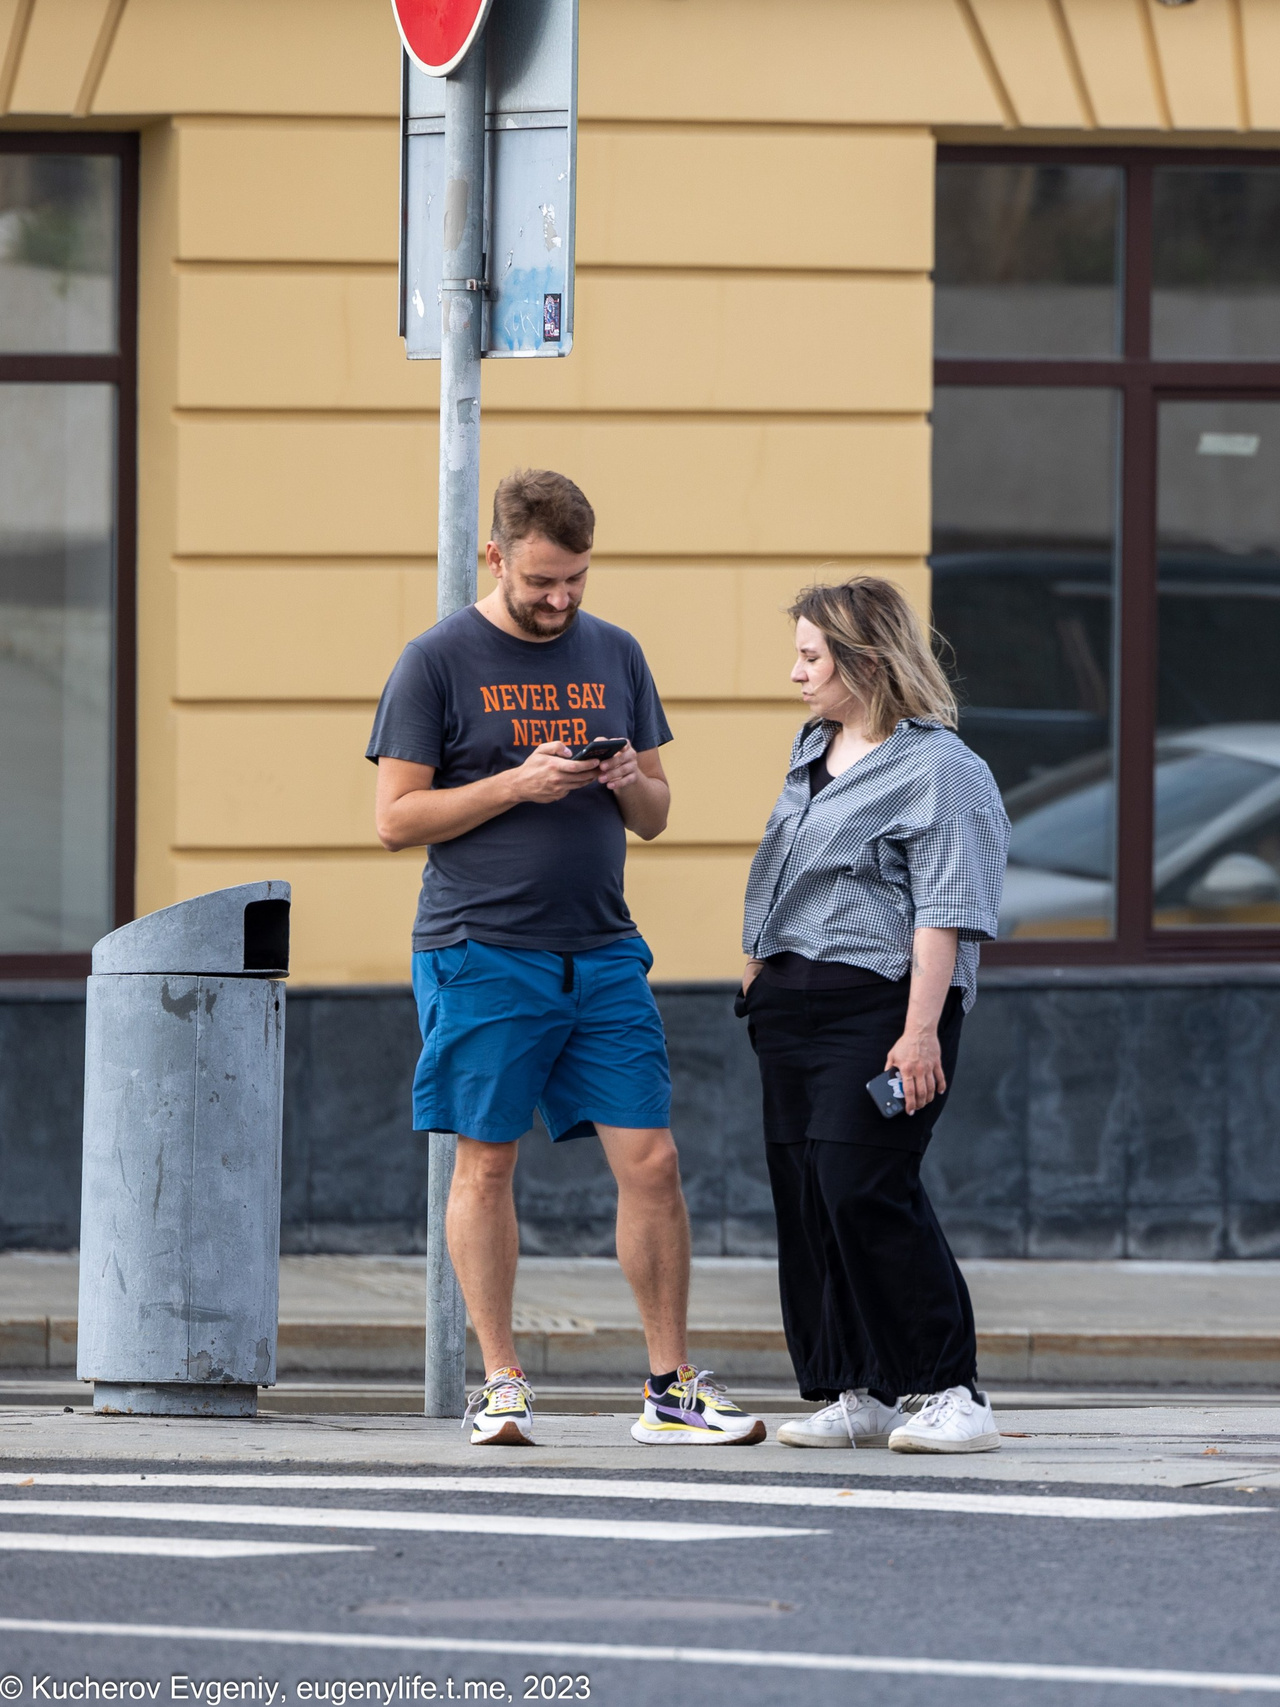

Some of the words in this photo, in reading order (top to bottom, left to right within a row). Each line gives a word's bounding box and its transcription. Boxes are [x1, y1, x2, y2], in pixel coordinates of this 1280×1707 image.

[480, 684, 560, 713] NEVER
[567, 683, 606, 710] SAY
[511, 718, 589, 747] NEVER
